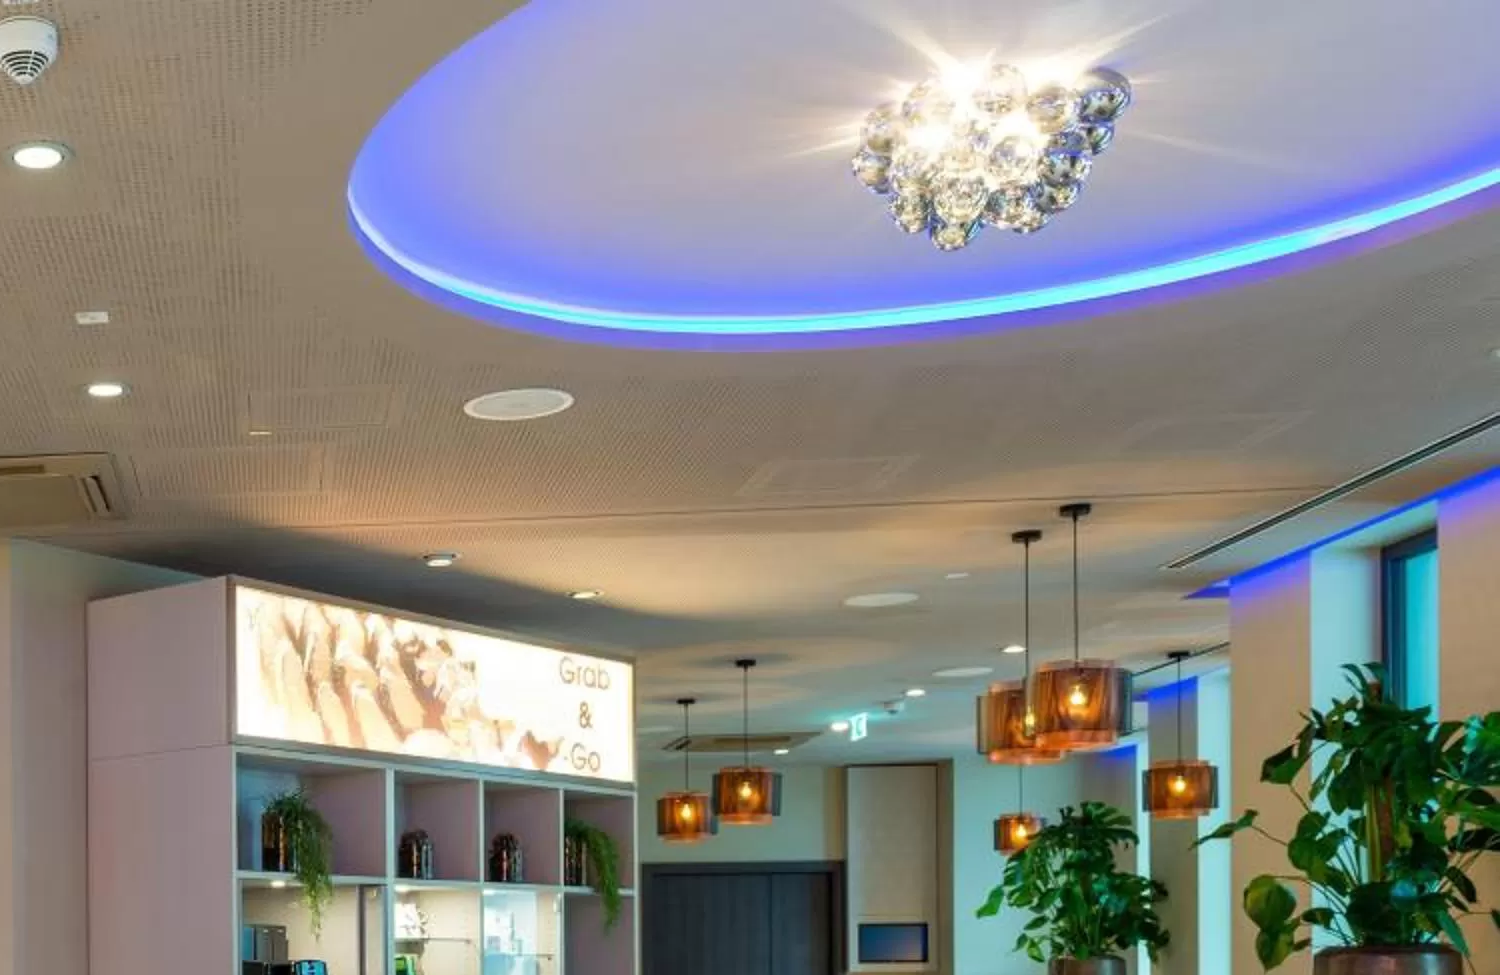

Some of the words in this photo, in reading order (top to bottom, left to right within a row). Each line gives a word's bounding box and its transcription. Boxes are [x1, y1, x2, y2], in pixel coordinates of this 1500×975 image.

[559, 656, 610, 690] Grab
[579, 700, 593, 728] &
[570, 742, 601, 772] Go
